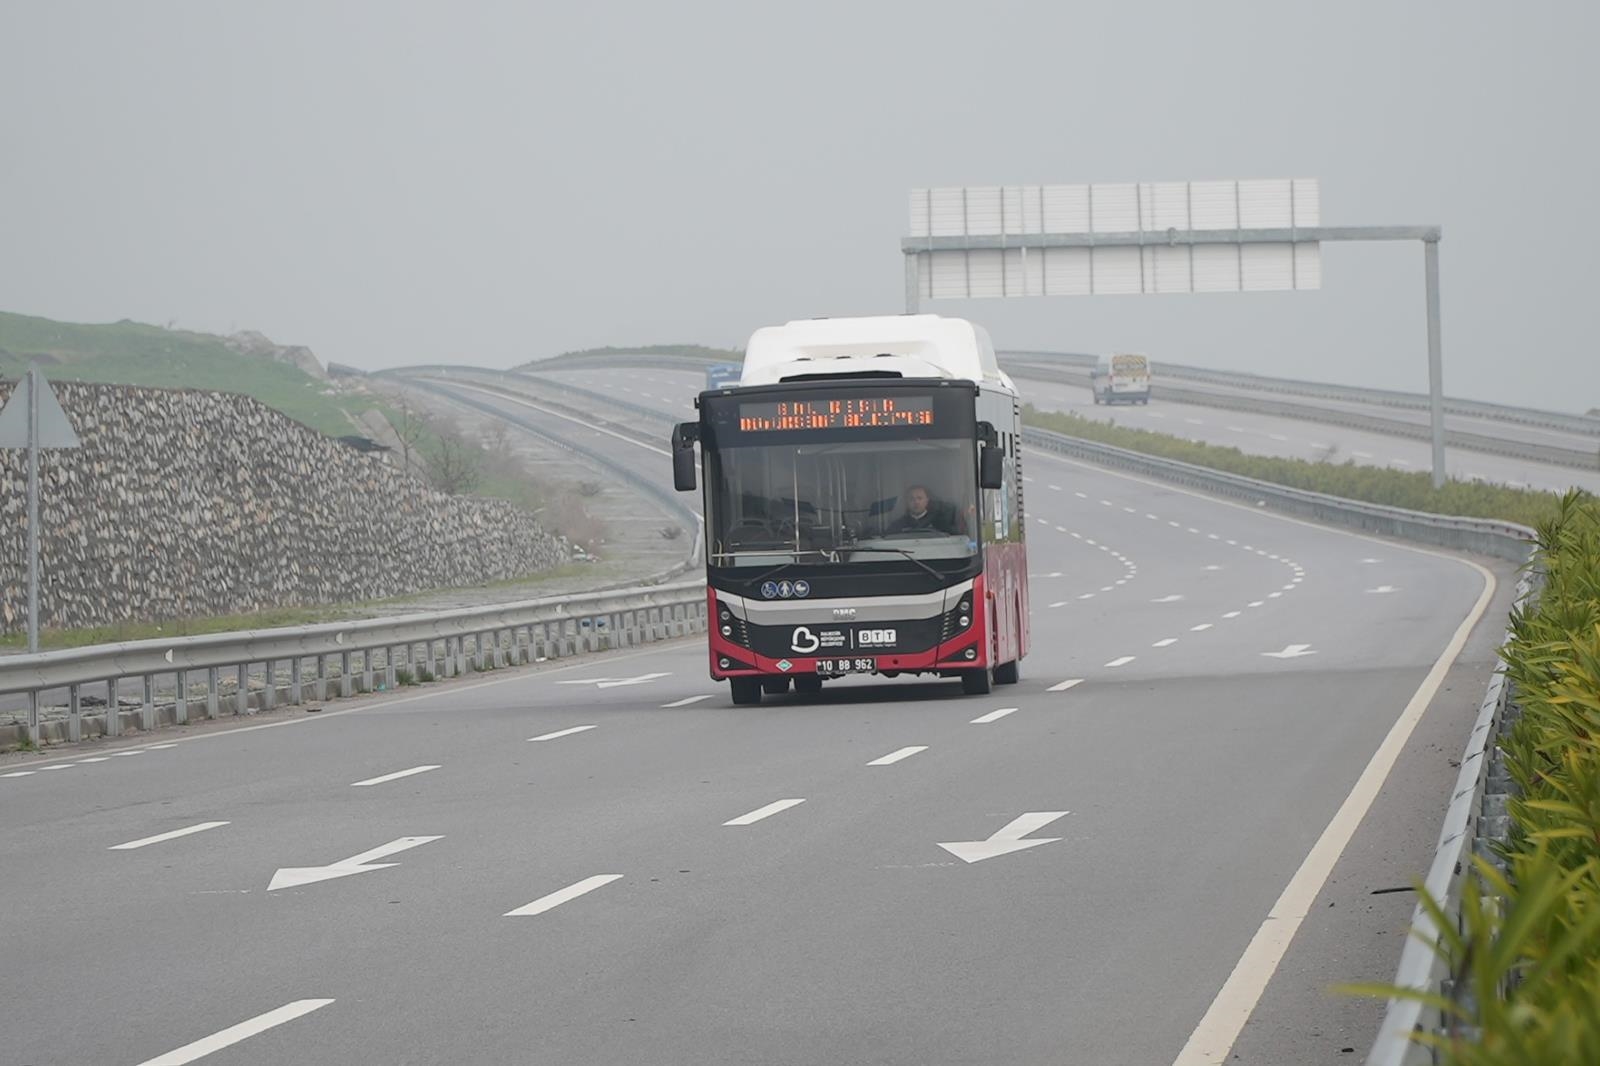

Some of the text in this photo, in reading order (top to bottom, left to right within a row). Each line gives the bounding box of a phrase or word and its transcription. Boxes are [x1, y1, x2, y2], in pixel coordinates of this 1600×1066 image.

[860, 630, 895, 642] BTT
[822, 660, 833, 671] 10
[854, 658, 872, 670] 962
